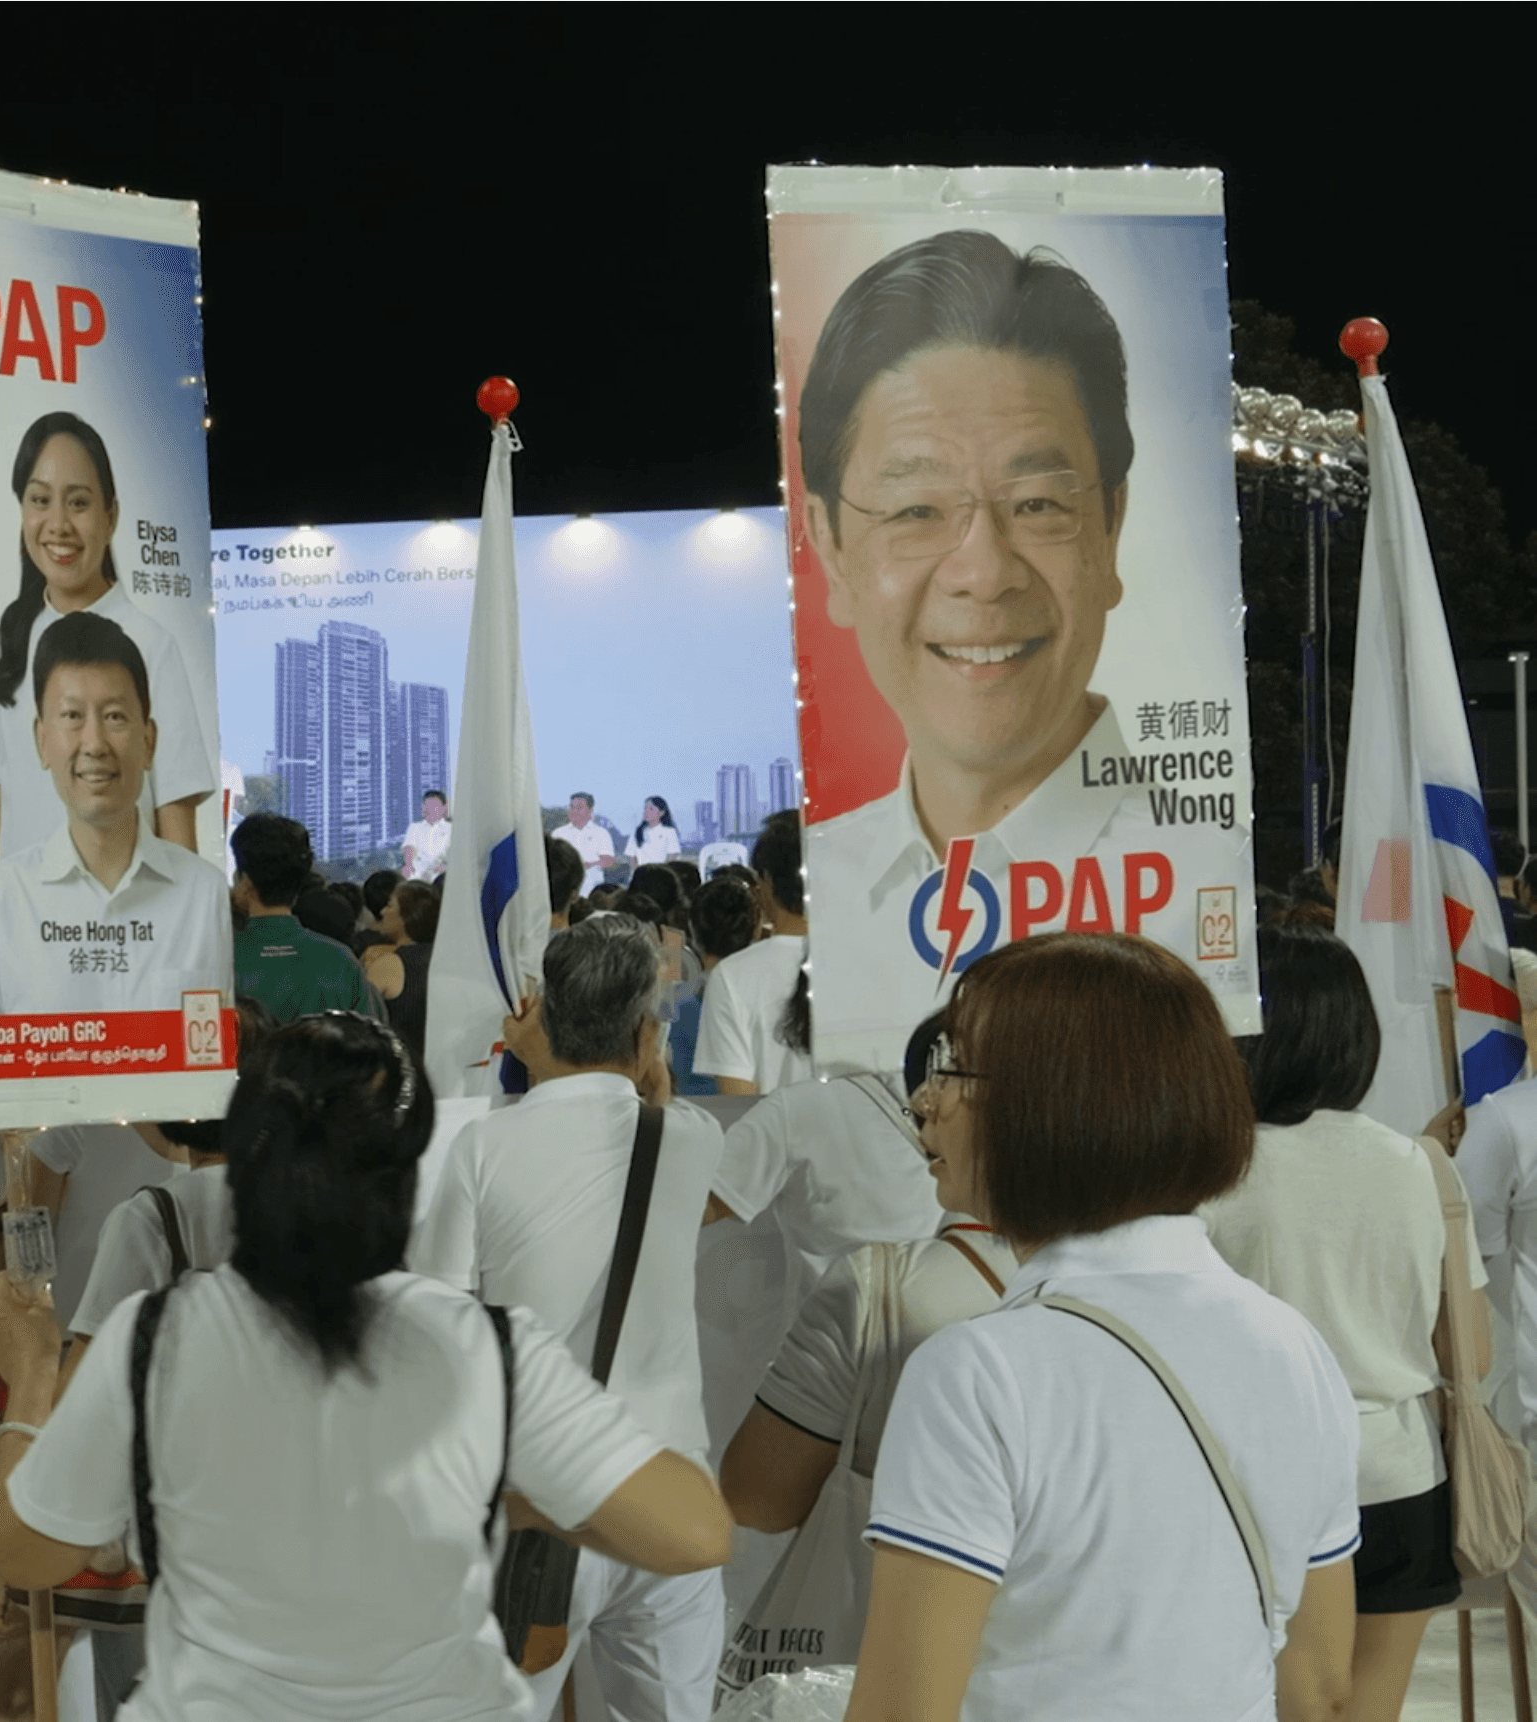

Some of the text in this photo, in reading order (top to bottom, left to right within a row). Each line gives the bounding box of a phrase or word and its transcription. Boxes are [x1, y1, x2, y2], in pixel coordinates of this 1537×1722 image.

[137, 519, 178, 545] Elysa
[140, 543, 181, 567] Chen
[235, 543, 335, 565] Together
[132, 568, 192, 599] 陈诗韵
[235, 573, 277, 589] Masa
[280, 571, 332, 588] Depan
[335, 569, 381, 584] Lebih
[383, 567, 433, 583] Cerah
[436, 565, 478, 581] Bers
[1136, 697, 1232, 743] 黄循财
[1081, 748, 1235, 788] Lawrence
[1148, 787, 1236, 831] Wong
[1008, 851, 1176, 942] PAP
[40, 920, 154, 947] Chee Hong Tat
[68, 946, 130, 974] 徐芳达
[20, 1021, 70, 1048] Payoh
[73, 1019, 107, 1043] GRC
[778, 1627, 826, 1656] RACES
